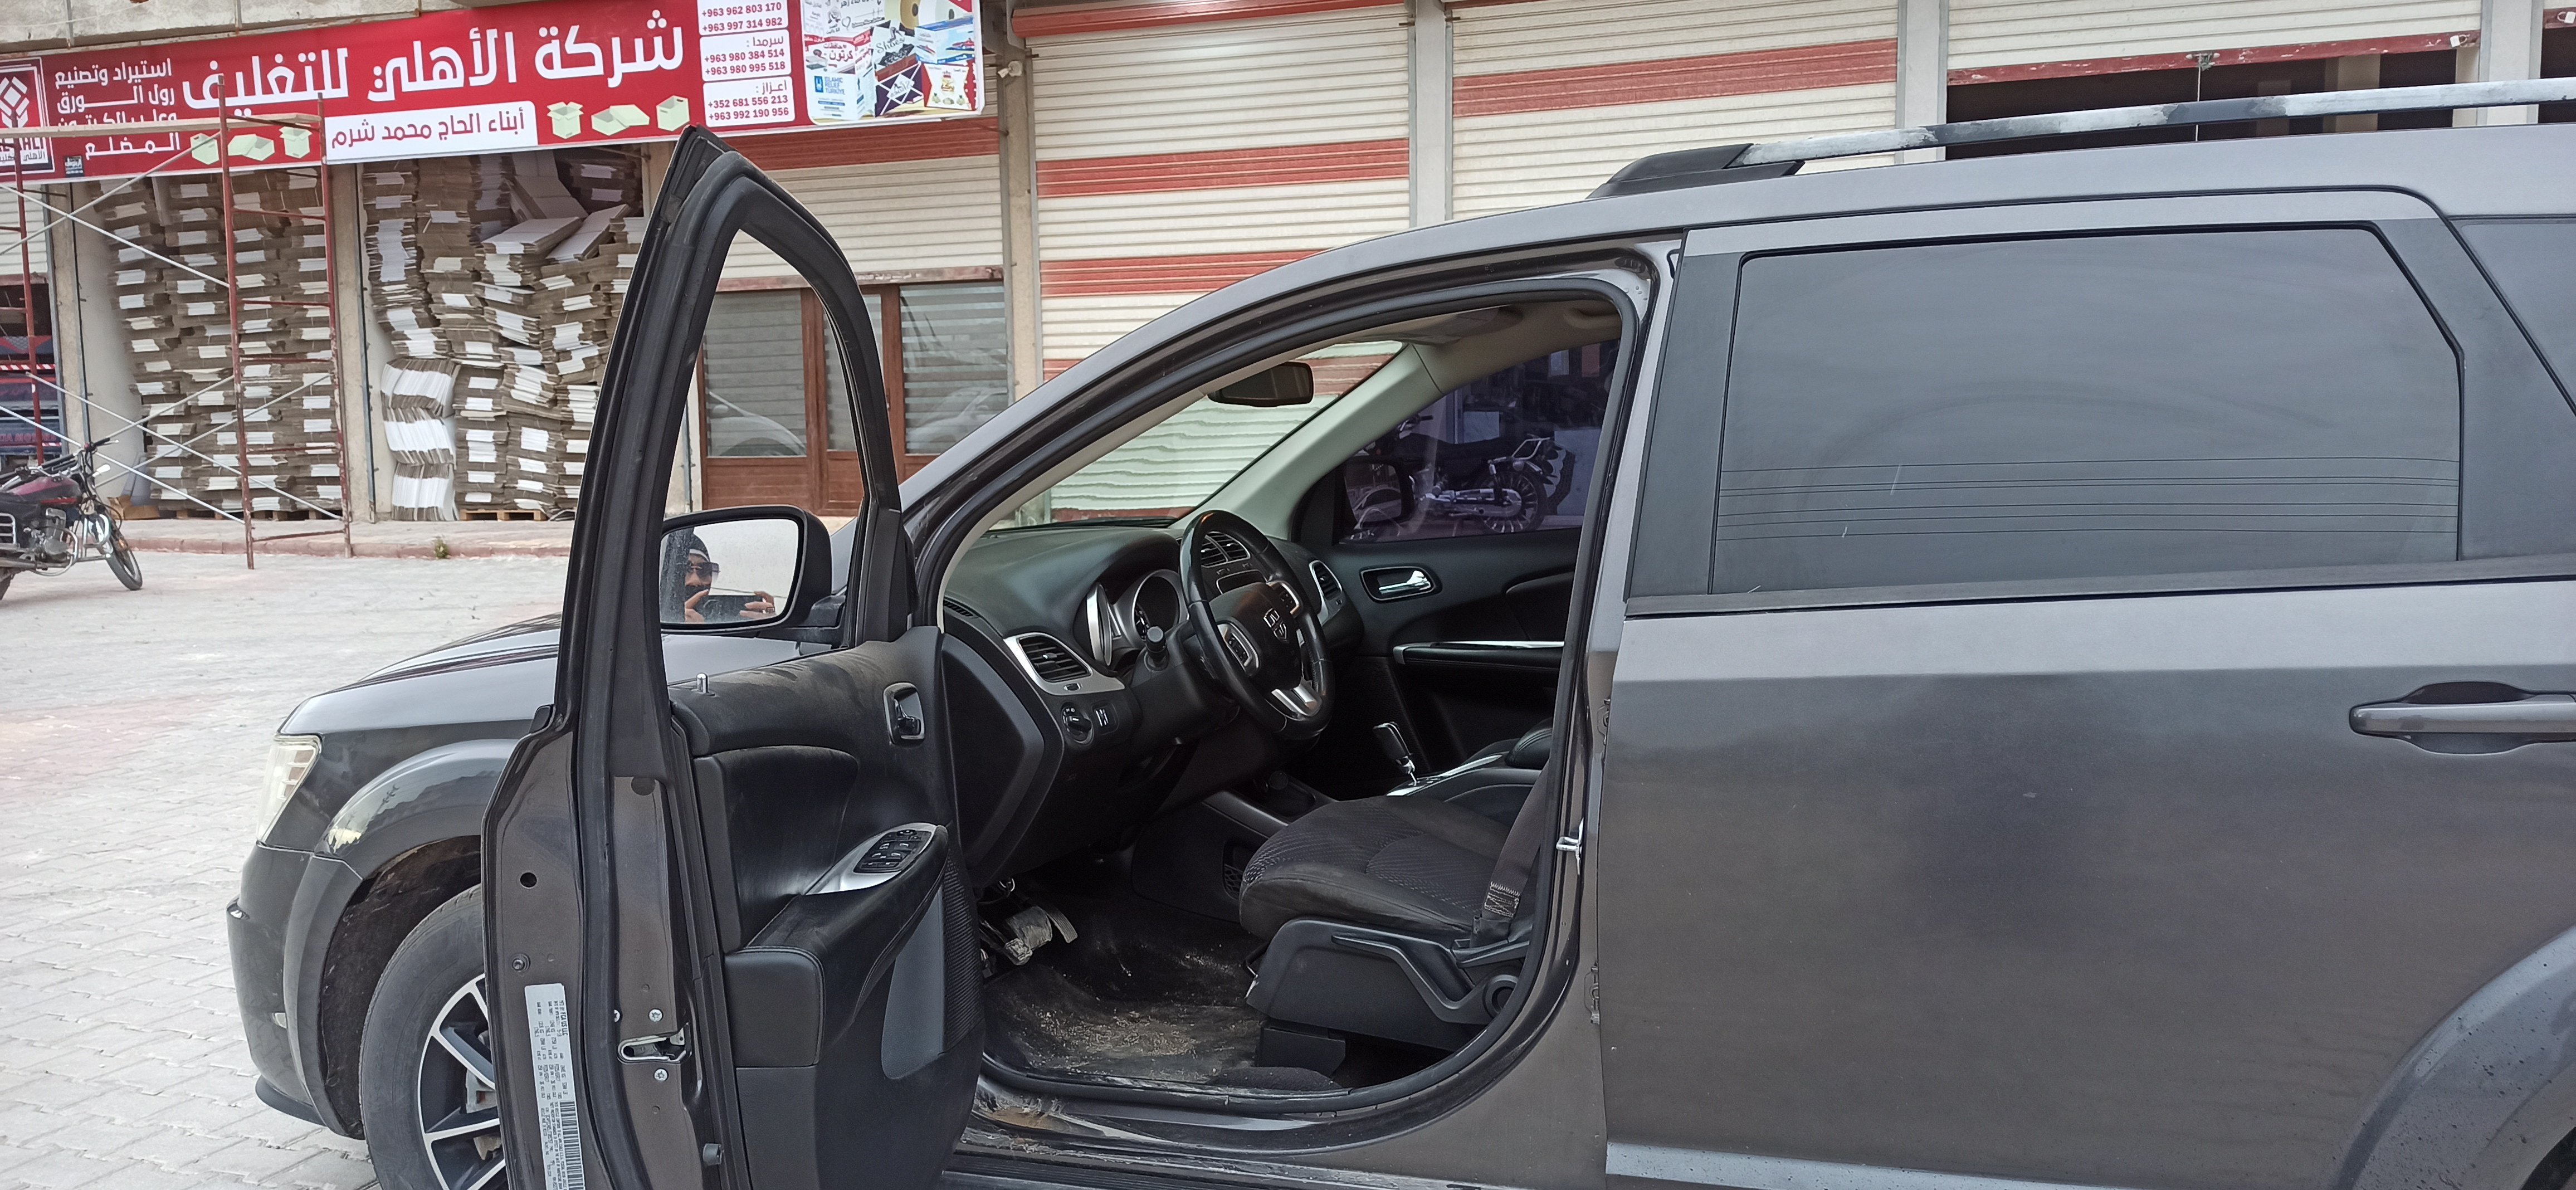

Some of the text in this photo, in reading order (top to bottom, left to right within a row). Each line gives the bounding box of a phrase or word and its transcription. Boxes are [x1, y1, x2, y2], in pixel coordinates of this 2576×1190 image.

[702, 2, 782, 17] +963 962 803 170
[702, 17, 782, 32] +963 997 314 982
[753, 36, 784, 47] سرمدا
[182, 9, 683, 117] شركة الأهلي للتغليف
[704, 48, 784, 63] +963 980 384 514
[55, 58, 172, 90] استيراد وتصنيع
[705, 61, 786, 75] +963 980 995 518
[57, 84, 174, 114] رول الورق
[708, 95, 788, 109] +352 681 556 213
[709, 108, 789, 121] +963 992 190 956
[331, 107, 524, 149] أبناء الحاج محمد شرم
[85, 132, 181, 160] المضلع
